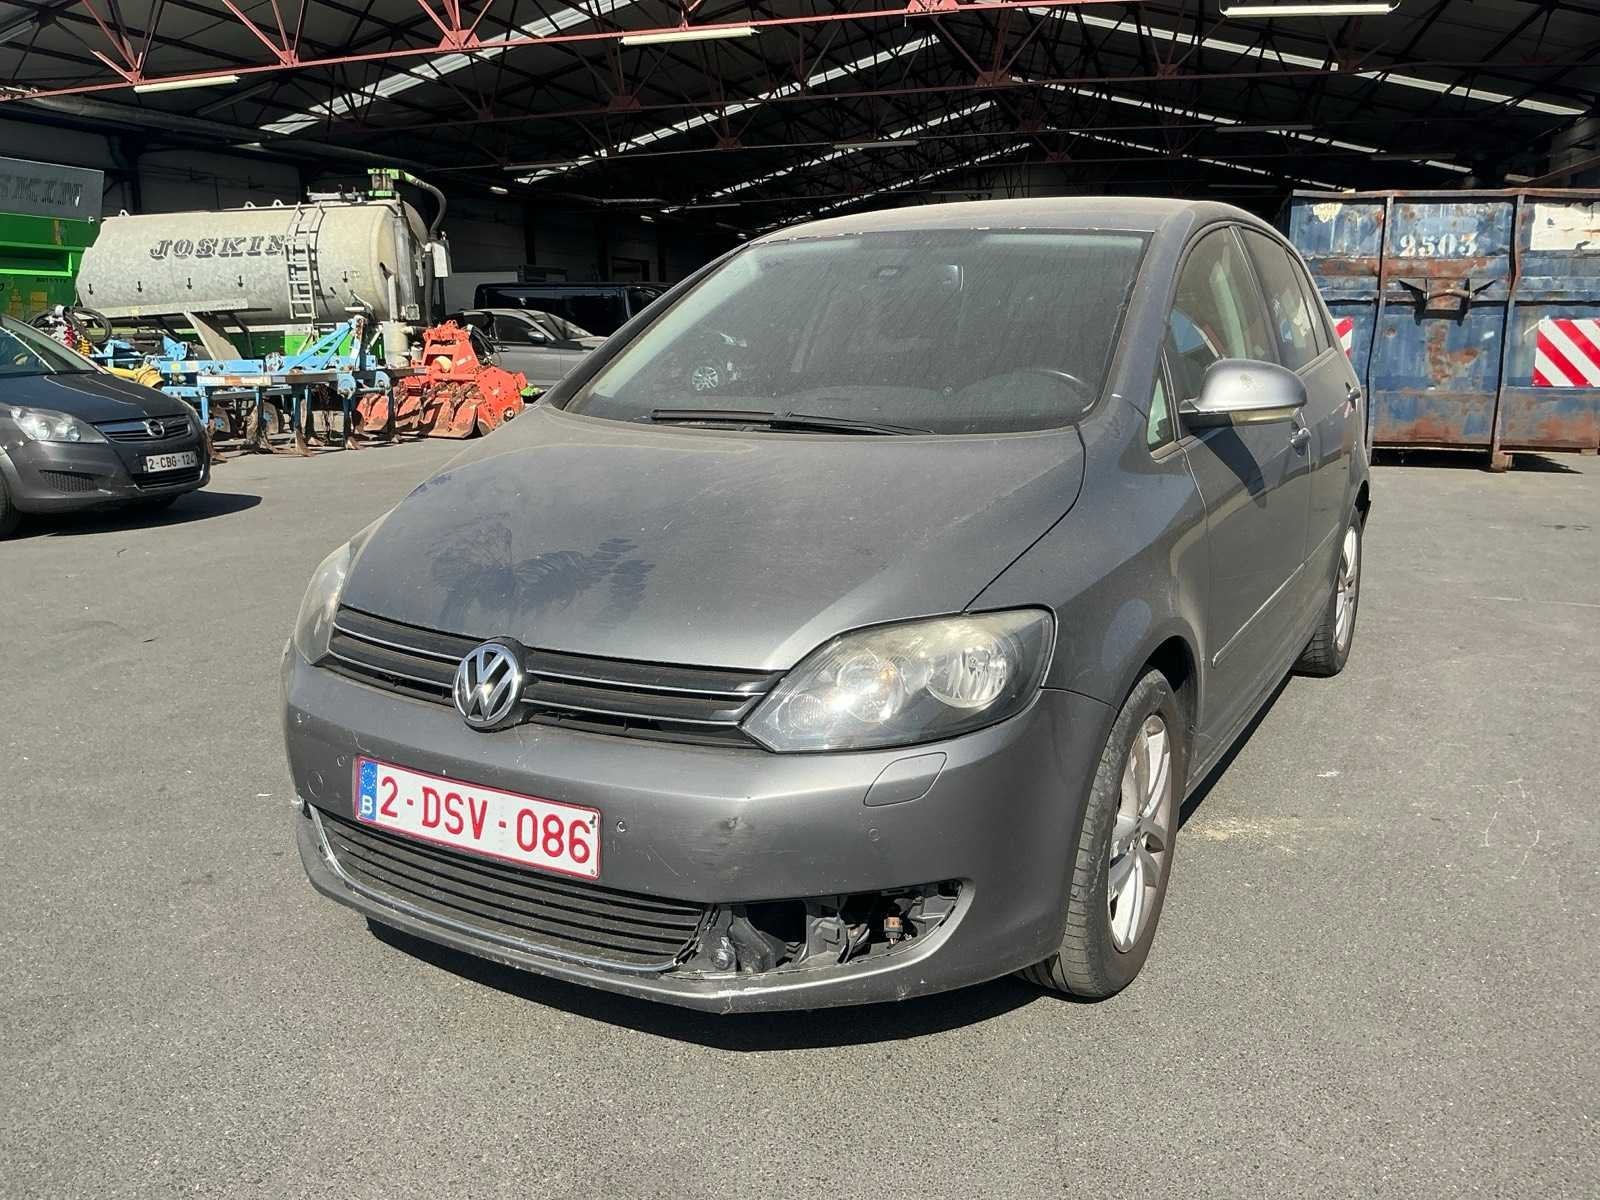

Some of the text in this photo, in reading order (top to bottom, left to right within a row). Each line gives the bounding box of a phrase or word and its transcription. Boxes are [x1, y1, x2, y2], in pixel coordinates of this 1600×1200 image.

[150, 235, 286, 260] JOSKIN
[1399, 232, 1479, 257] 2503
[362, 795, 374, 815] B
[380, 775, 591, 864] 2-DSV-086
